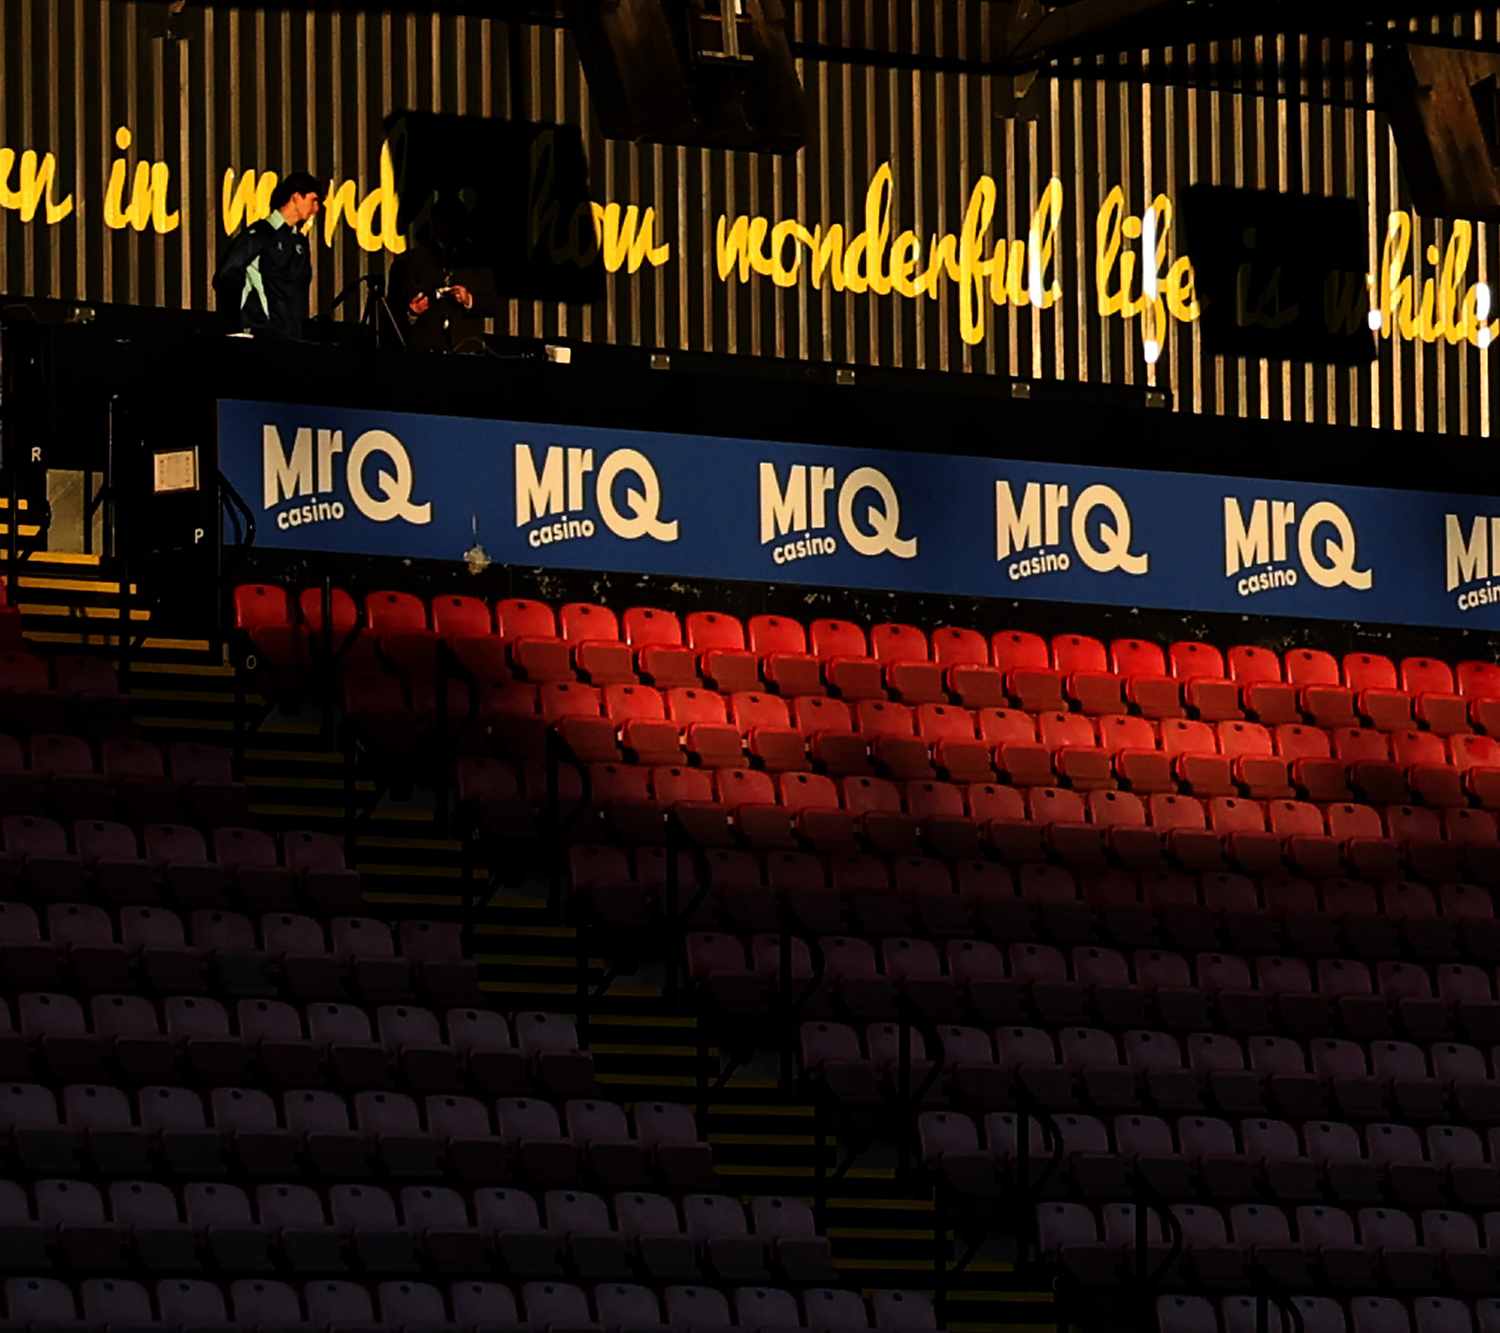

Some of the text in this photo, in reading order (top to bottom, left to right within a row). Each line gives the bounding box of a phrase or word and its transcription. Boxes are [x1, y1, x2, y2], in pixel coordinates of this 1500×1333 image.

[104, 126, 190, 235] in
[716, 161, 1063, 345] wonderful
[1095, 183, 1208, 365] life
[31, 446, 42, 462] R
[263, 424, 432, 525] MrQ
[515, 443, 679, 543] MrQ
[759, 462, 917, 559] MrQ
[276, 497, 345, 531] casino
[528, 513, 595, 549] casino
[995, 480, 1148, 575] MrQ
[194, 528, 204, 544] P
[772, 530, 837, 566] casino
[1224, 496, 1373, 591] MrQ
[1008, 547, 1070, 582] casino
[1237, 564, 1298, 597] casino
